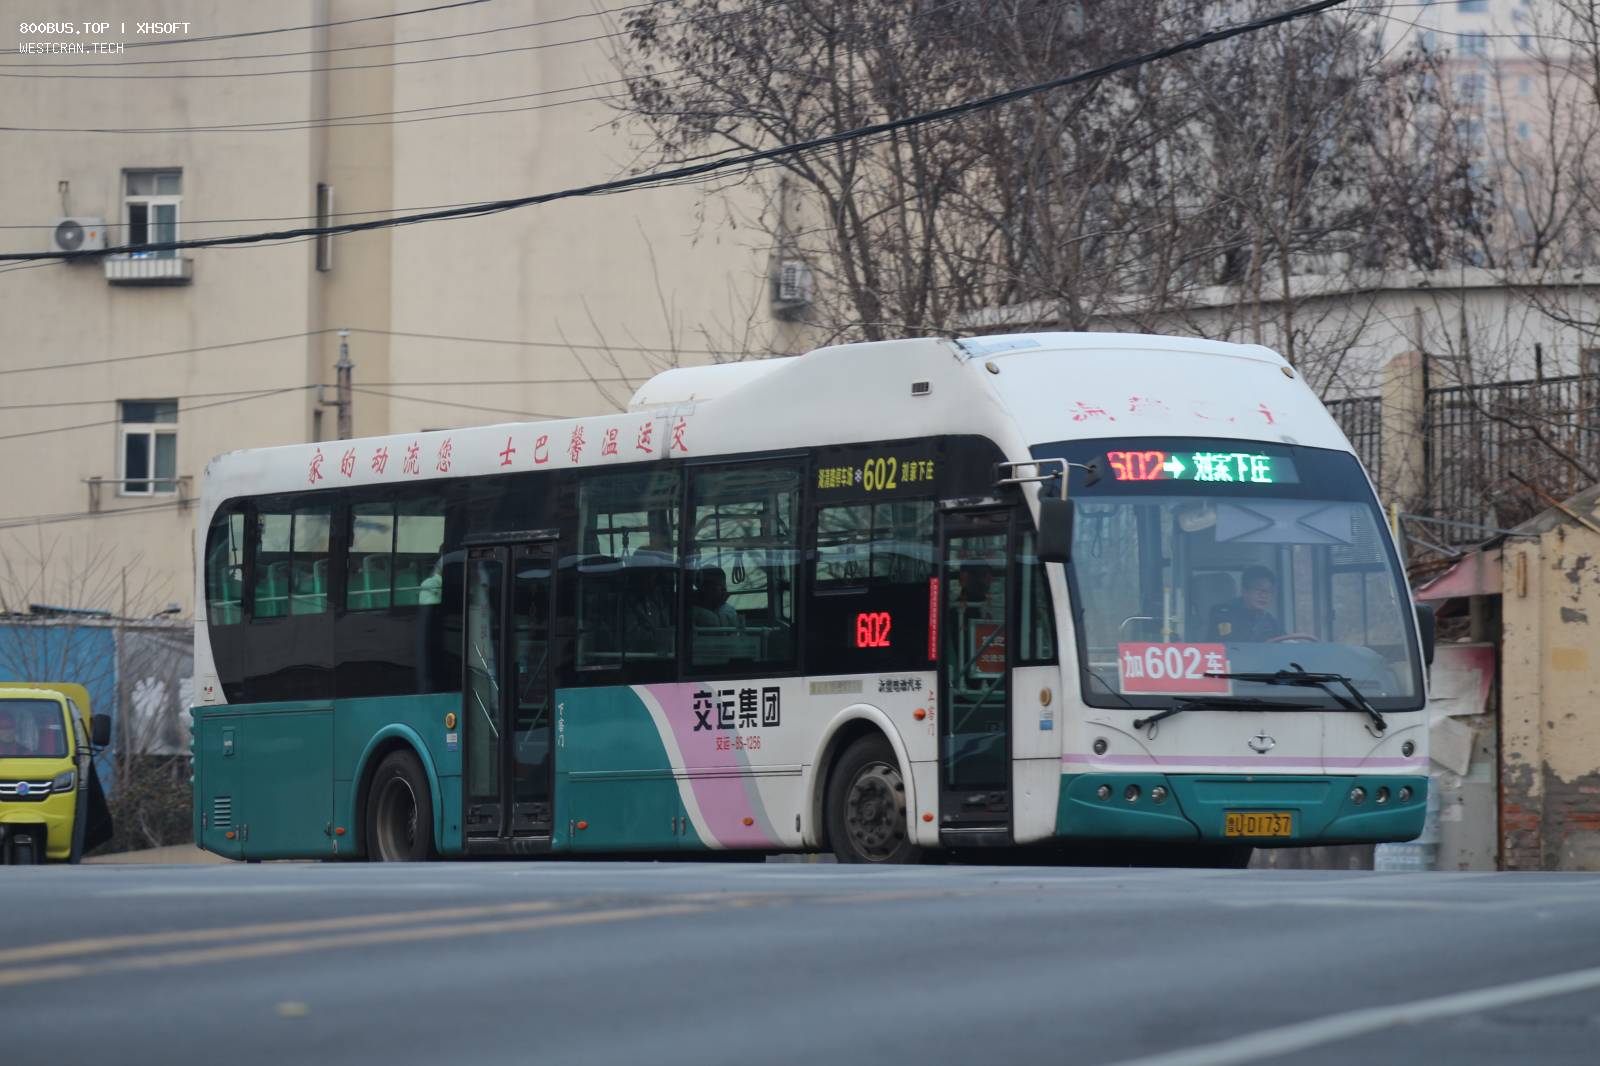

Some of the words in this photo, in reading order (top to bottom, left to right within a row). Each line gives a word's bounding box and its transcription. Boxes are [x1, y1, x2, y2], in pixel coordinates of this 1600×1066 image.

[863, 456, 898, 491] 602
[856, 612, 892, 648] 602
[692, 685, 781, 732] 交运集团
